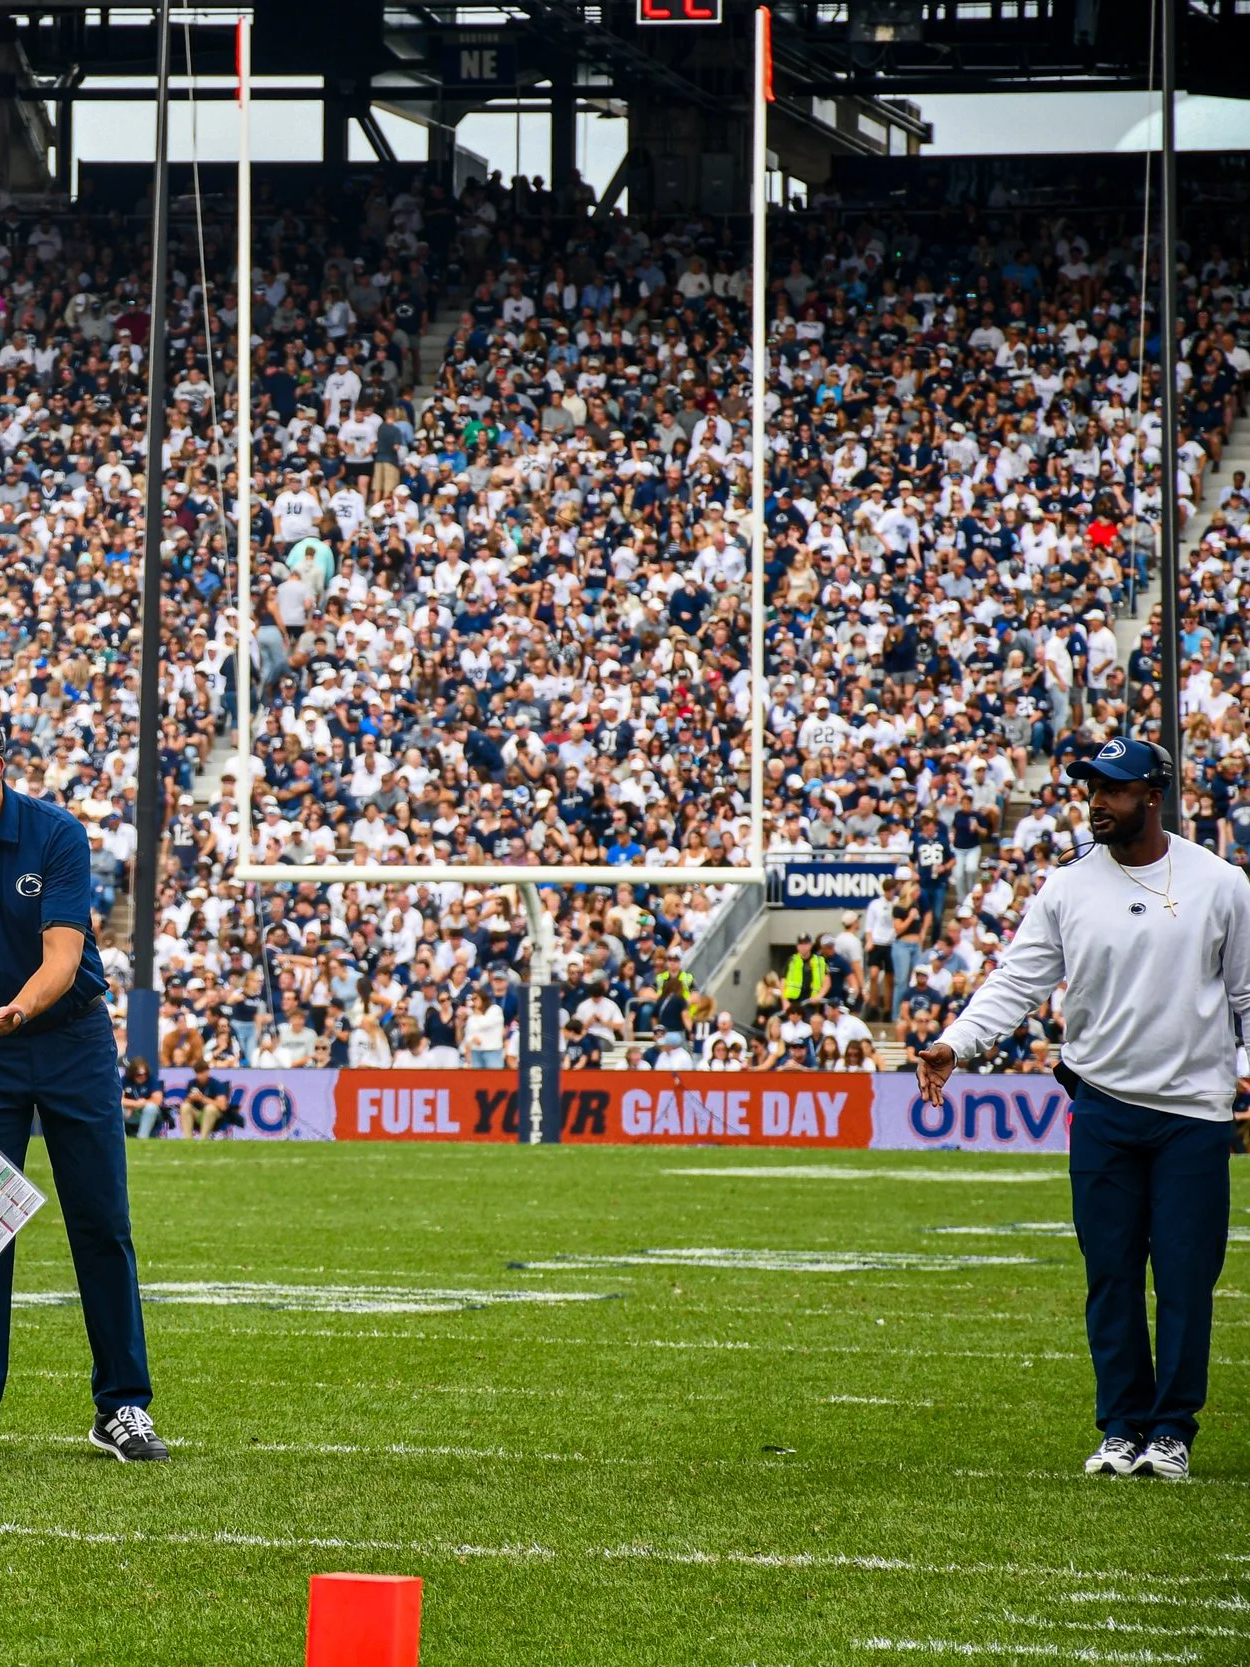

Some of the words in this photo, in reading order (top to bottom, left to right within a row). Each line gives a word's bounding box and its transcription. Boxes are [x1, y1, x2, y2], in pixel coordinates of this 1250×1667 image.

[460, 50, 498, 79] NE
[813, 727, 834, 743] 22
[174, 824, 193, 845] 12
[919, 844, 944, 865] 26
[528, 986, 542, 1052] PENN
[357, 1088, 461, 1134] FUEL
[621, 1088, 751, 1136] GAME
[761, 1091, 848, 1137] DAY
[908, 1091, 1075, 1142] onv
